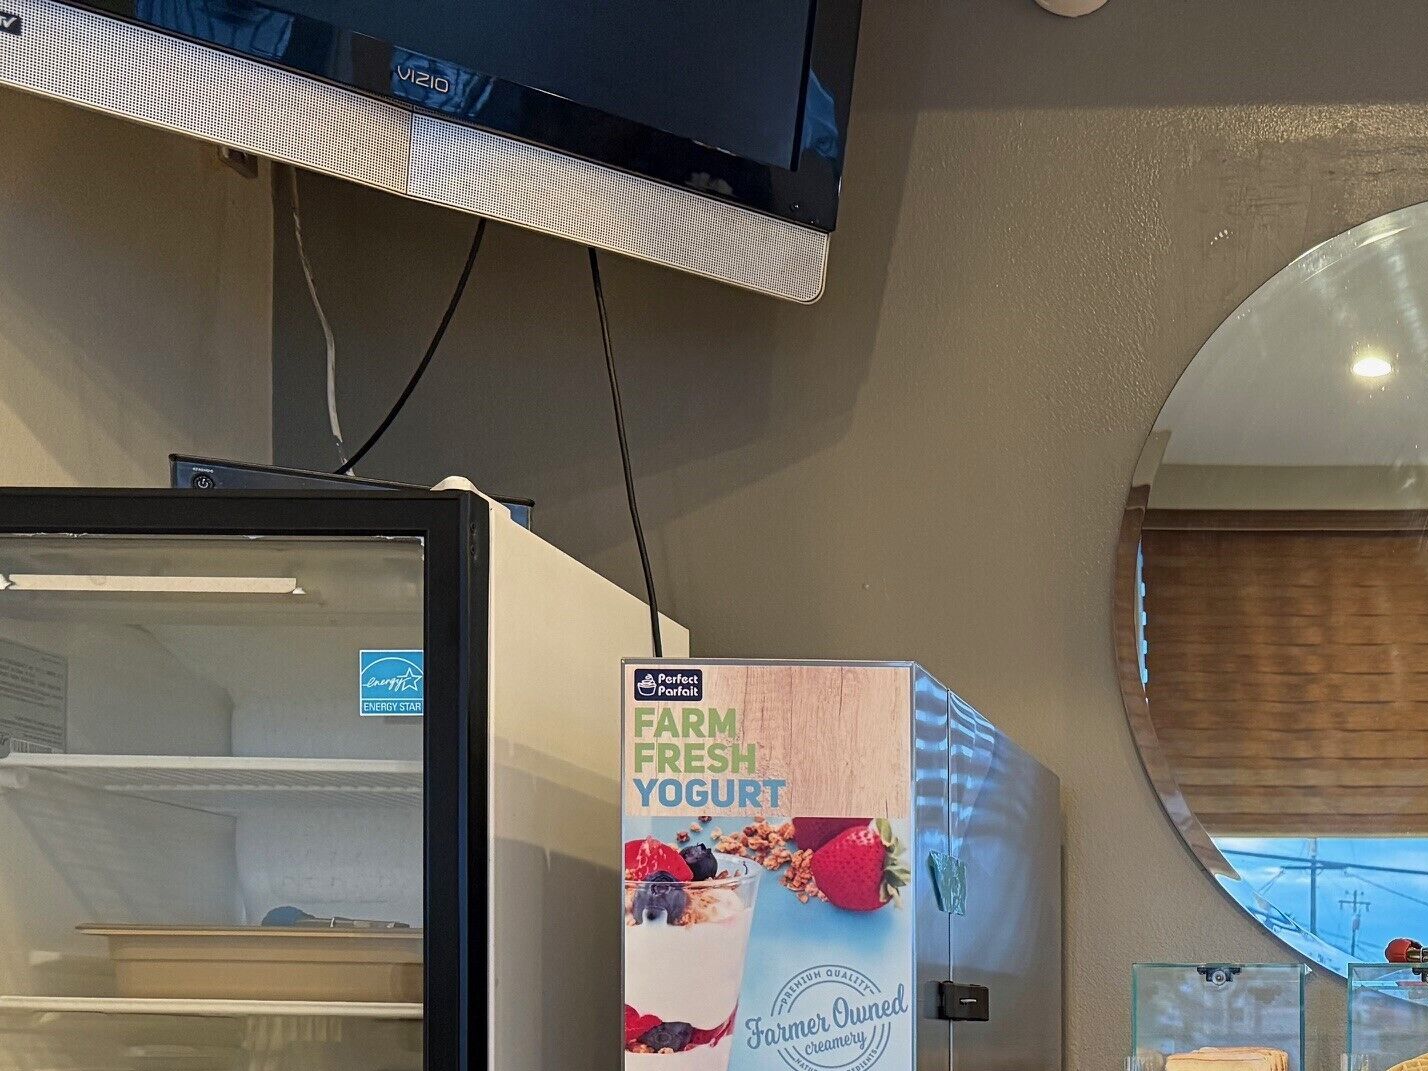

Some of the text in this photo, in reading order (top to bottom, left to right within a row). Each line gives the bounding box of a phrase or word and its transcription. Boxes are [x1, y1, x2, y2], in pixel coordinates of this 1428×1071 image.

[397, 65, 449, 93] VIZIO
[658, 673, 699, 684] Perfect
[658, 685, 699, 697] Parfait
[363, 702, 422, 712] ENERGY STAR
[634, 707, 737, 738] FARM
[634, 742, 757, 774] FRESH
[632, 778, 787, 809] YOGURT
[782, 968, 870, 1005] PREMIUM QUALITY
[744, 982, 909, 1050] Farmer Owned
[804, 1030, 868, 1056] creamery
